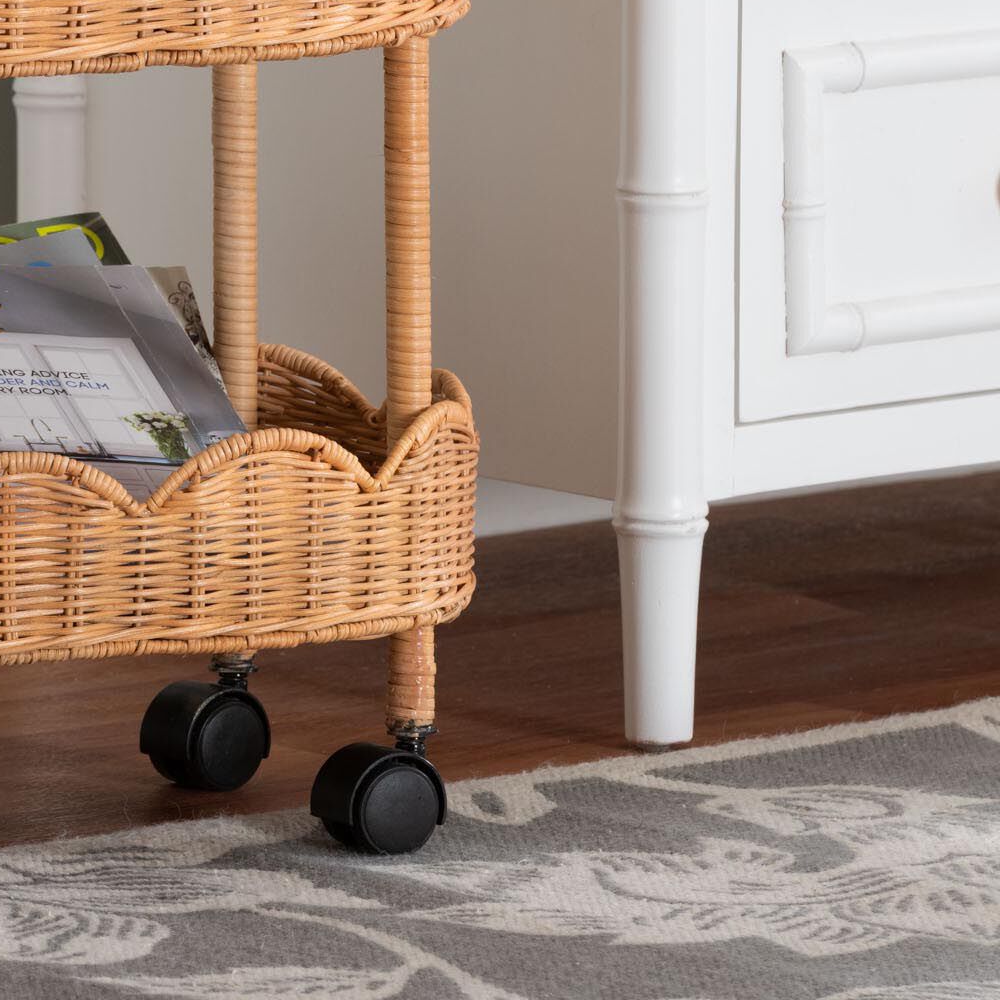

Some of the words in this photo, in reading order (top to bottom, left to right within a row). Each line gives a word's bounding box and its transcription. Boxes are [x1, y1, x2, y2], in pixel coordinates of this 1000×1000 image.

[31, 370, 90, 380] ADVICE
[30, 378, 62, 387] AND
[65, 380, 109, 390] CALM
[19, 386, 72, 396] ROOM.
